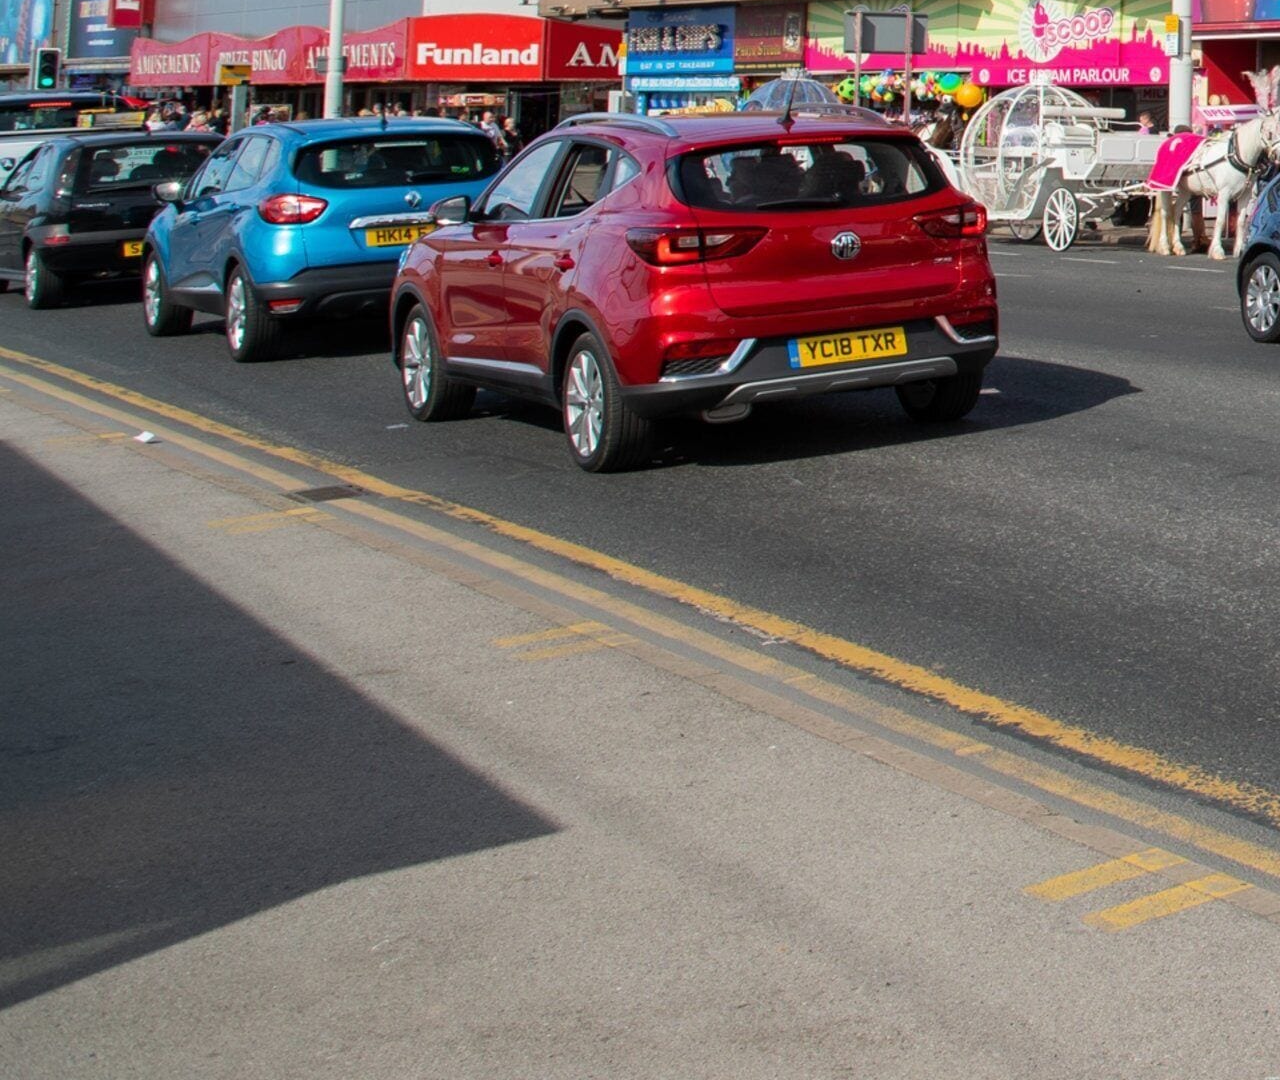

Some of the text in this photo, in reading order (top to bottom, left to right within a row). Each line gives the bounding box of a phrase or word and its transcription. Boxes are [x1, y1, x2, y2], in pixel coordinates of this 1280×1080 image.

[629, 24, 721, 52] FISH & CHIPS
[1046, 8, 1113, 46] SCOOP
[136, 52, 202, 75] AMUSEMENTS
[252, 48, 288, 71] BINGO
[305, 42, 397, 69] AMMENTS
[416, 42, 540, 66] Funland
[640, 62, 653, 70] EAT
[679, 61, 715, 69] TAKEAWAY
[1006, 69, 1027, 82] ICE
[1073, 68, 1130, 82] PARLOUR
[1203, 109, 1233, 117] OPEN
[375, 228, 413, 243] HK14
[806, 332, 897, 360] YC18 TXR
